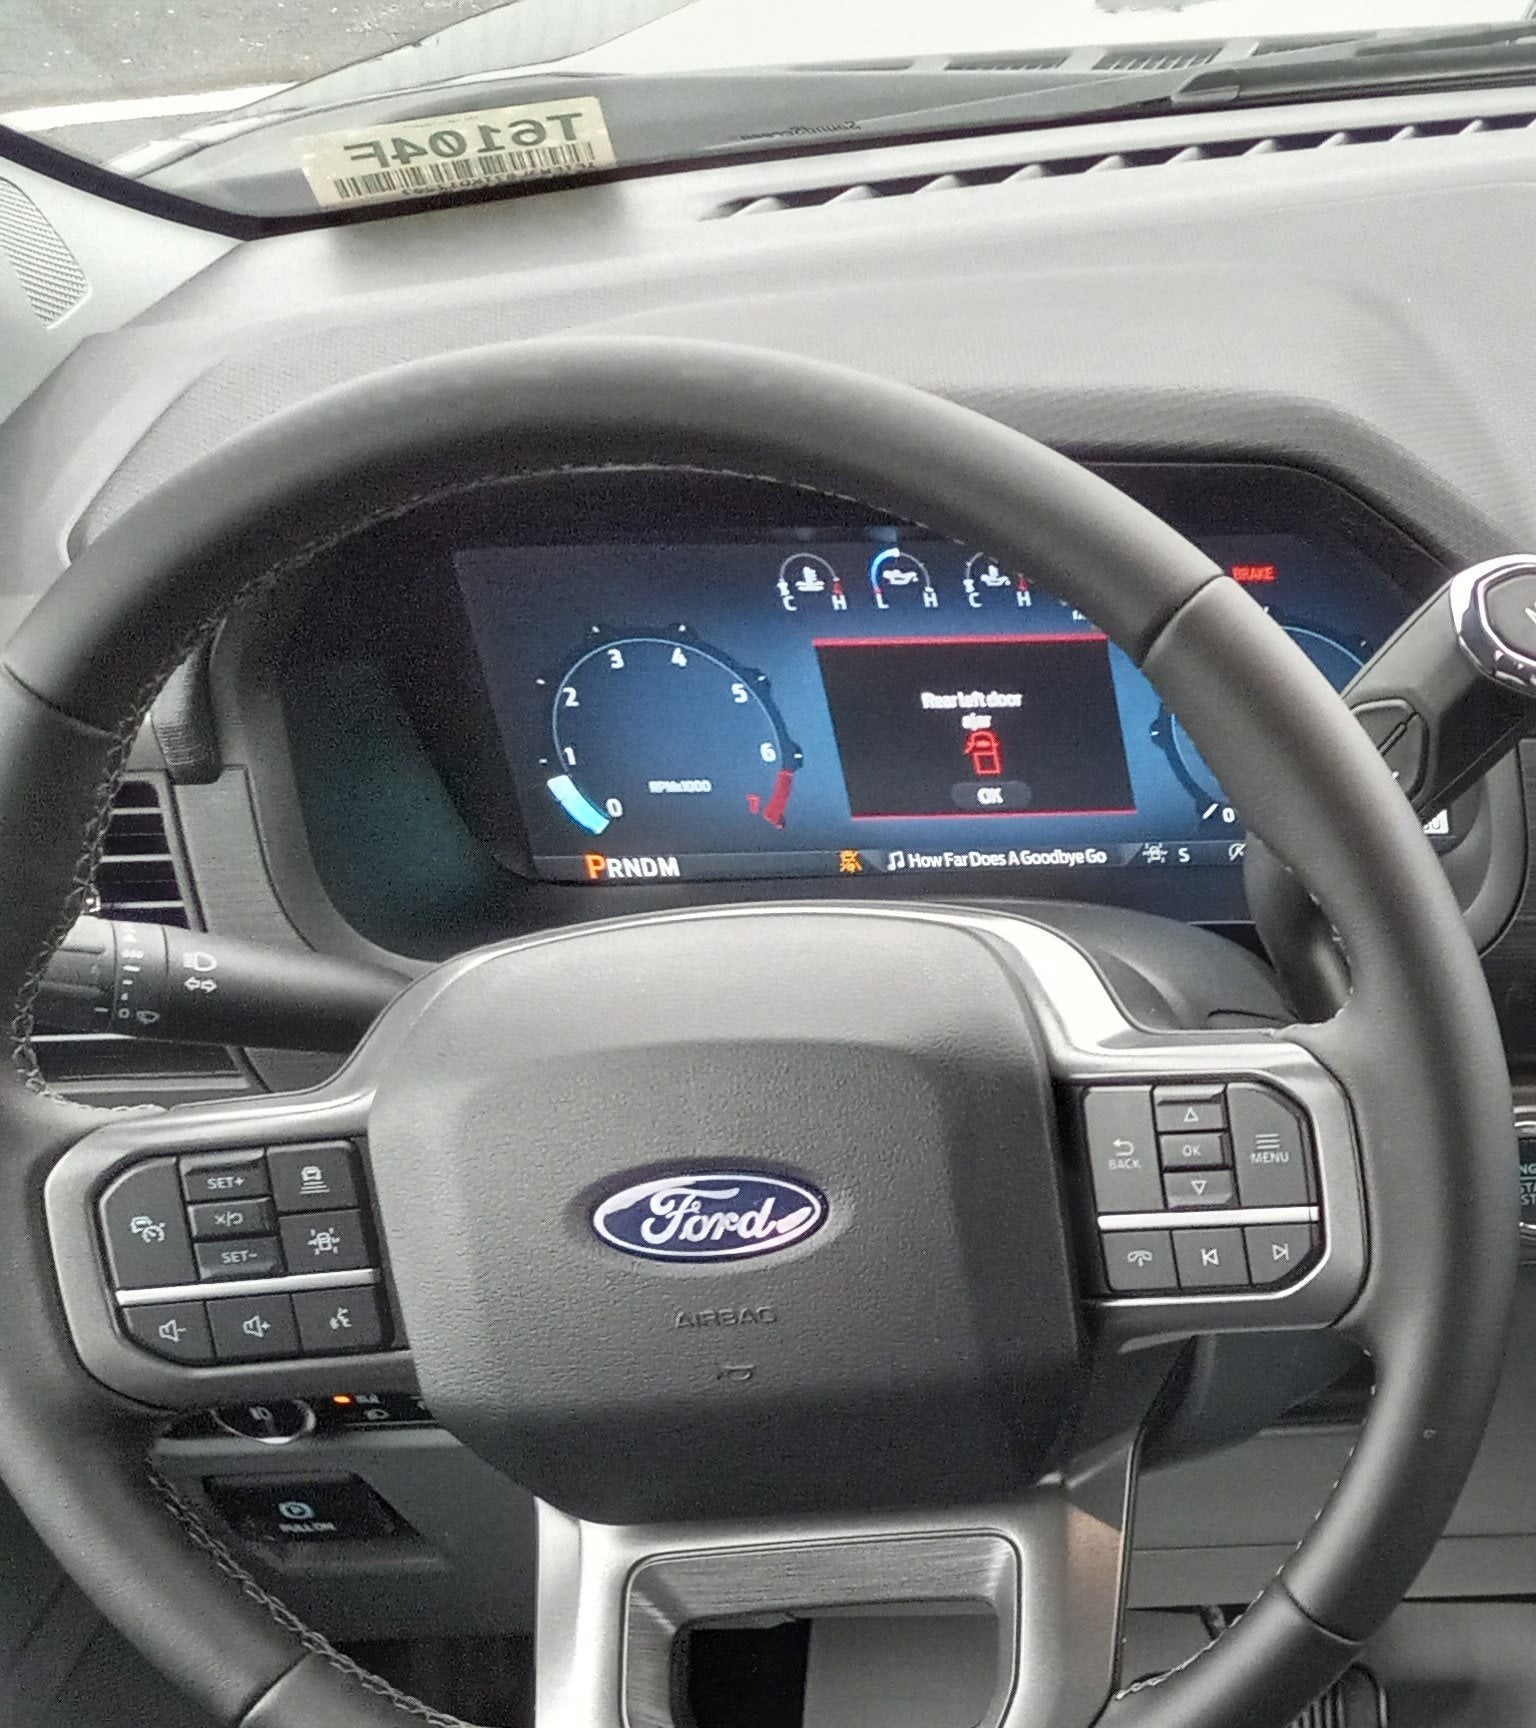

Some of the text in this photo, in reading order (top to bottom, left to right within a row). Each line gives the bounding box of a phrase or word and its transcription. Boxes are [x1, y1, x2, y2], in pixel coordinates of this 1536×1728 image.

[1232, 565, 1276, 582] BRAKE
[608, 649, 624, 668] 3
[672, 648, 687, 667] 4
[563, 688, 579, 706] 2
[732, 683, 748, 702] 5
[565, 747, 576, 765] 1
[760, 743, 776, 762] 6
[606, 798, 622, 817] 0
[908, 849, 1107, 868] How Far Does A Goodbye Go
[1182, 1145, 1201, 1157] OK
[1251, 1152, 1289, 1163] MENU
[1109, 1159, 1141, 1169] BACK
[207, 1176, 244, 1190] SET+
[641, 1187, 777, 1245] Ford
